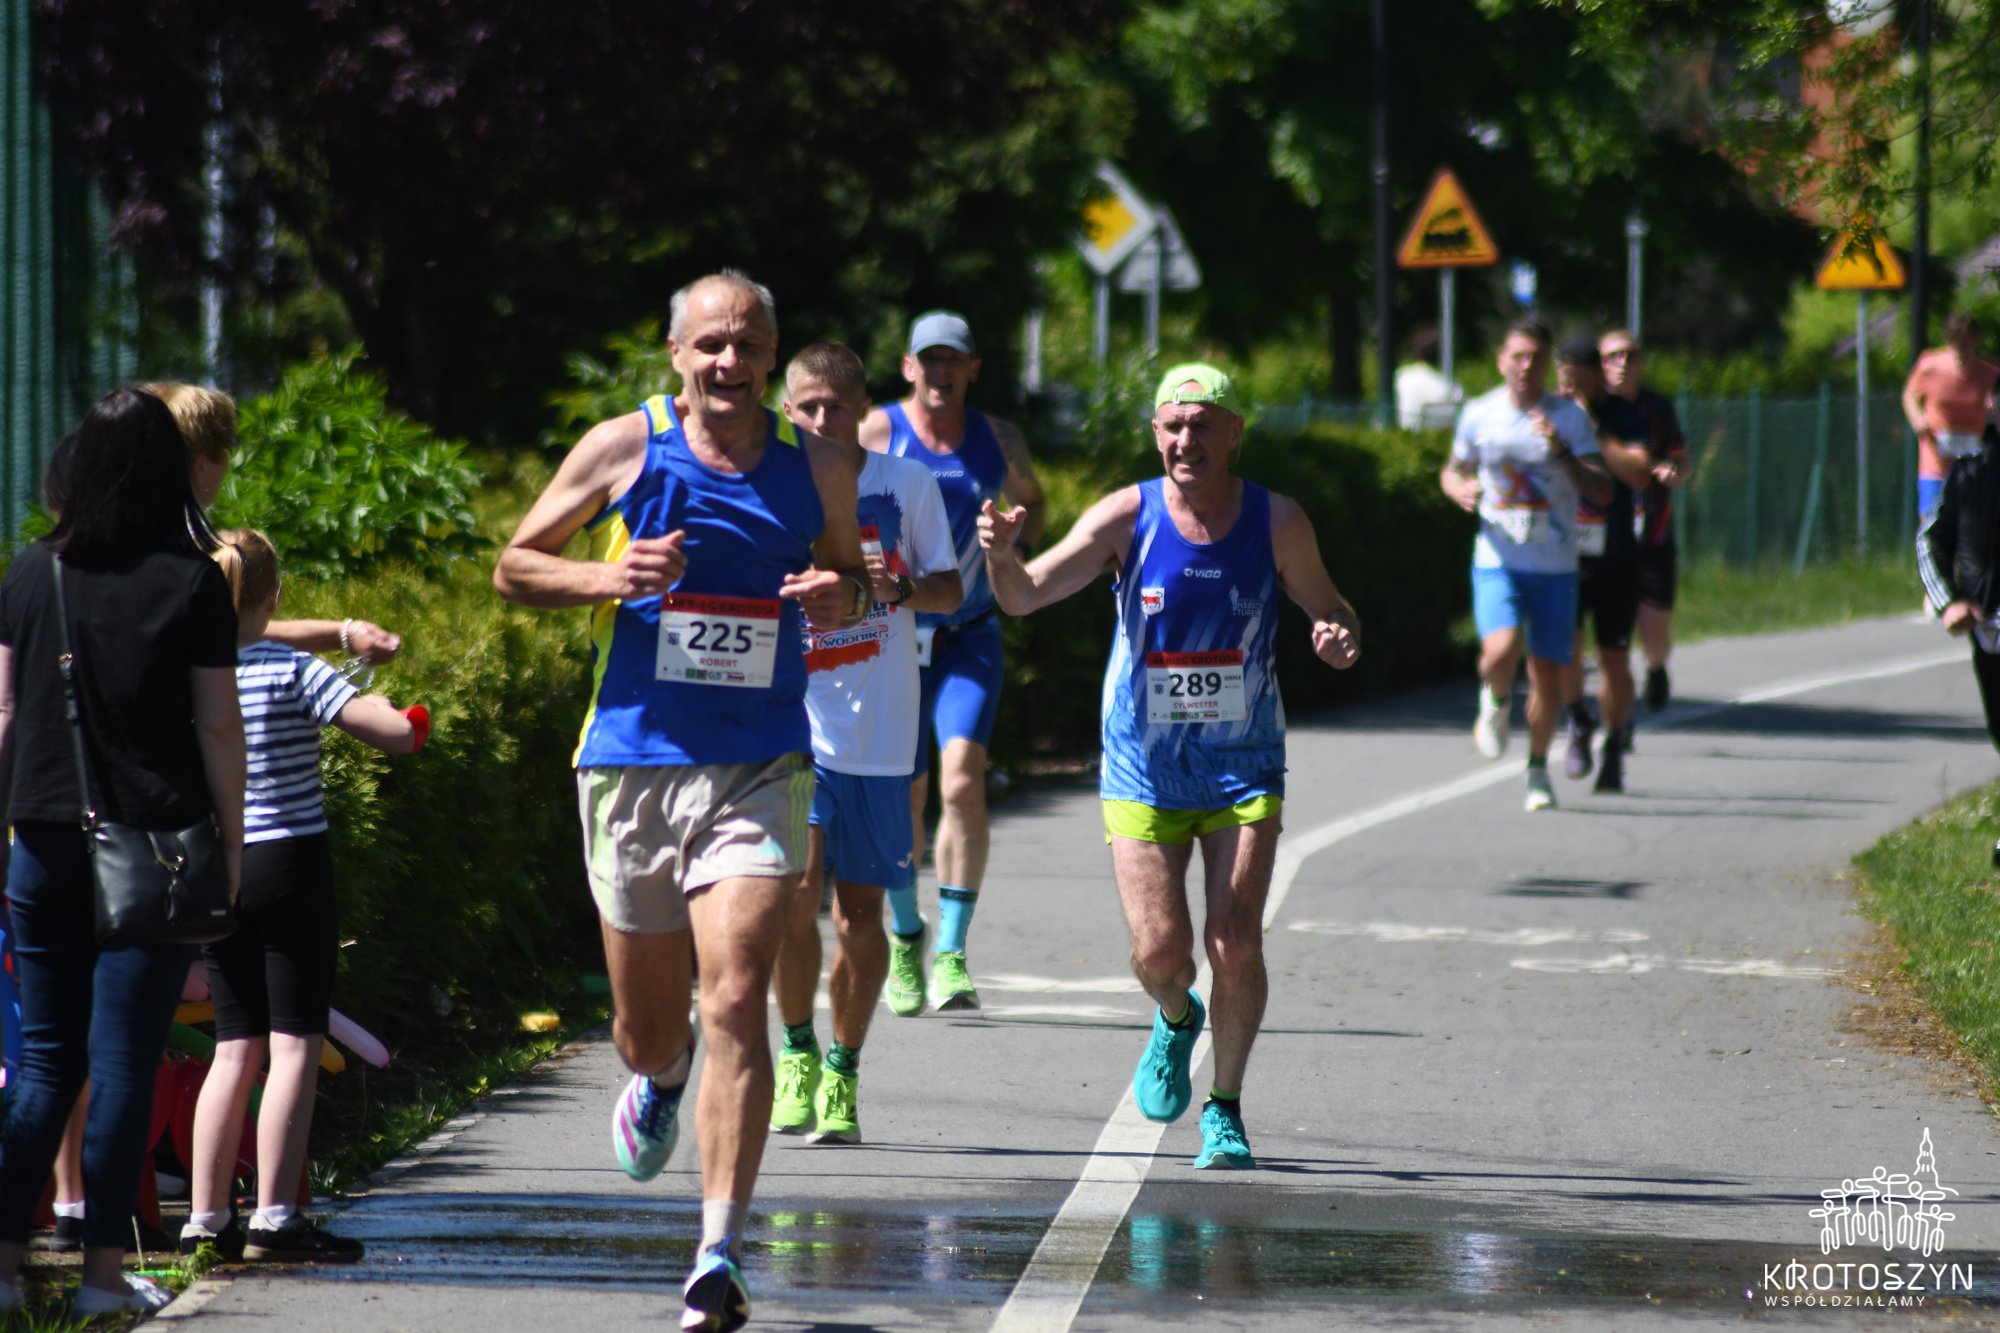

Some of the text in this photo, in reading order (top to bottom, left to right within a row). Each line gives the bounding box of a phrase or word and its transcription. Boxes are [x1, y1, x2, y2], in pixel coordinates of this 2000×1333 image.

[687, 620, 752, 655] 225
[823, 632, 878, 648] WODNIK
[700, 658, 739, 668] ROBERT
[1191, 654, 1239, 664] KROTOSA
[1169, 672, 1222, 697] 289
[1173, 700, 1219, 709] SYLWESTER
